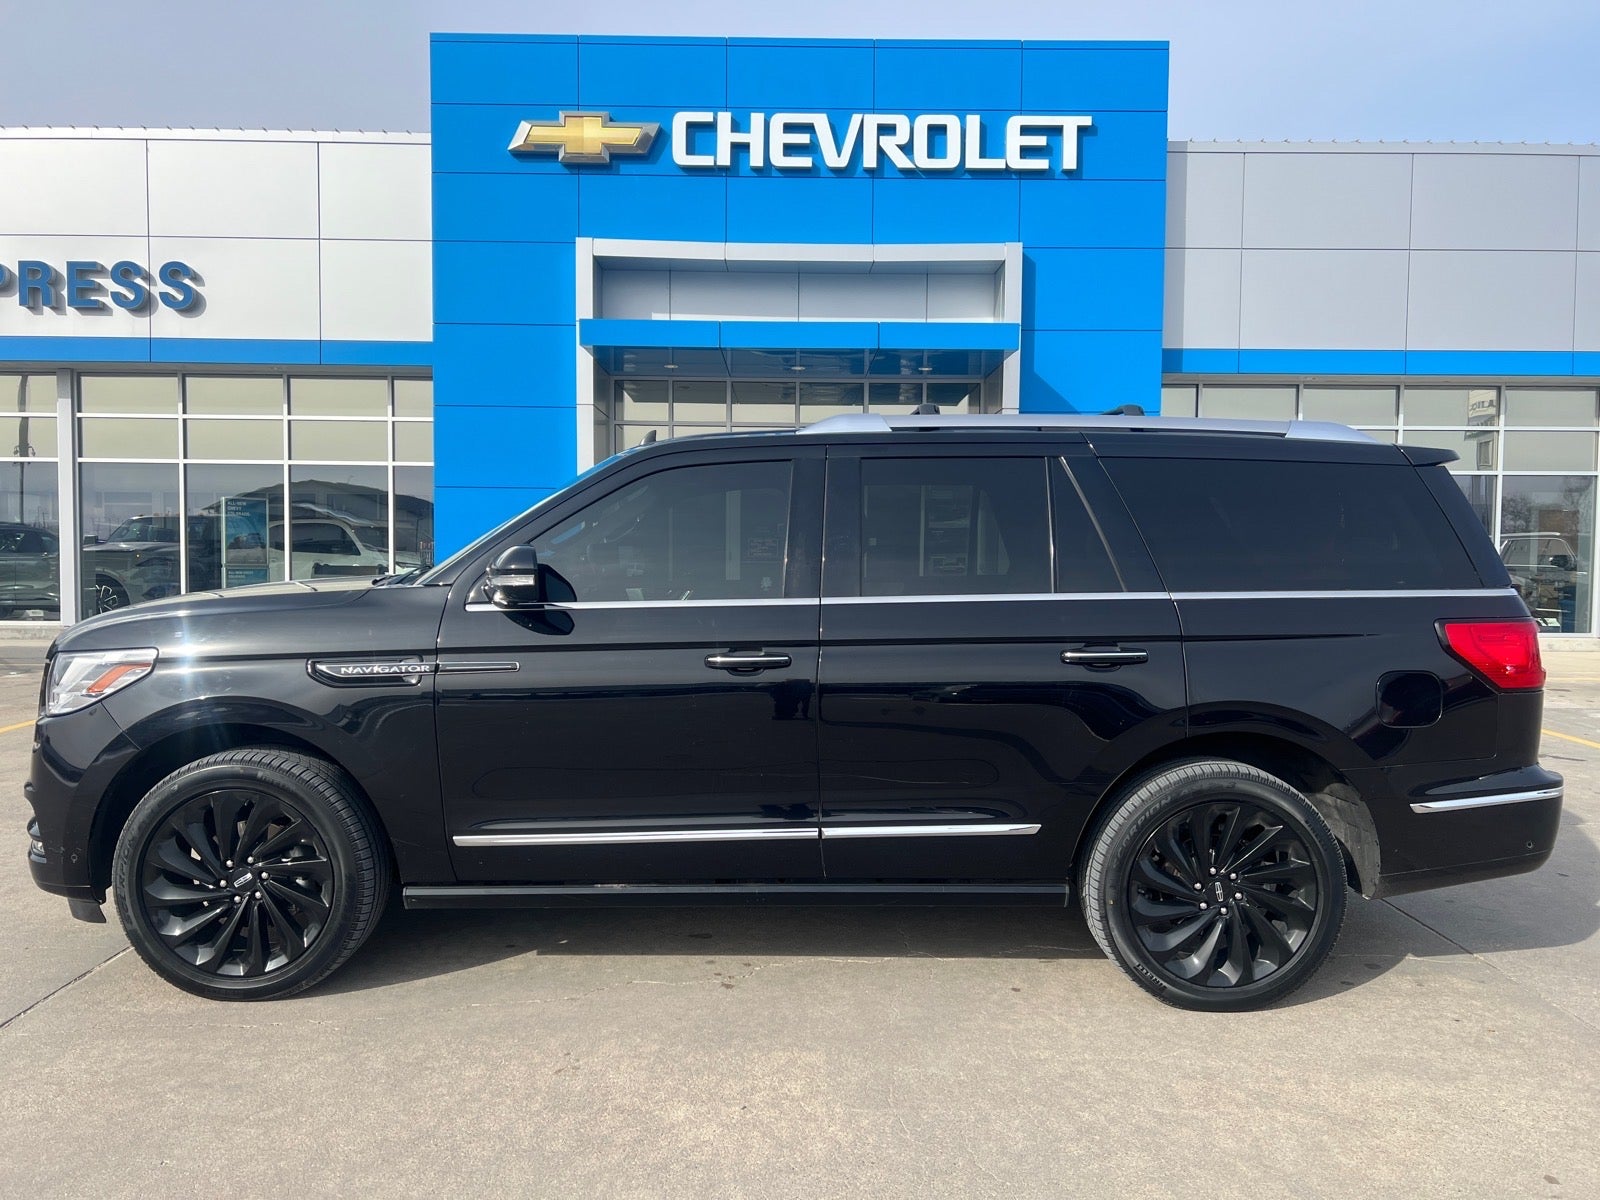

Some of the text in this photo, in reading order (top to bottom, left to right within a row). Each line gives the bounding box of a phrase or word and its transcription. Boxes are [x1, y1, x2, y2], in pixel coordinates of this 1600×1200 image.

[672, 111, 1093, 171] CHEVROLET
[0, 260, 198, 311] RESS
[340, 666, 430, 675] NAVIGATOR
